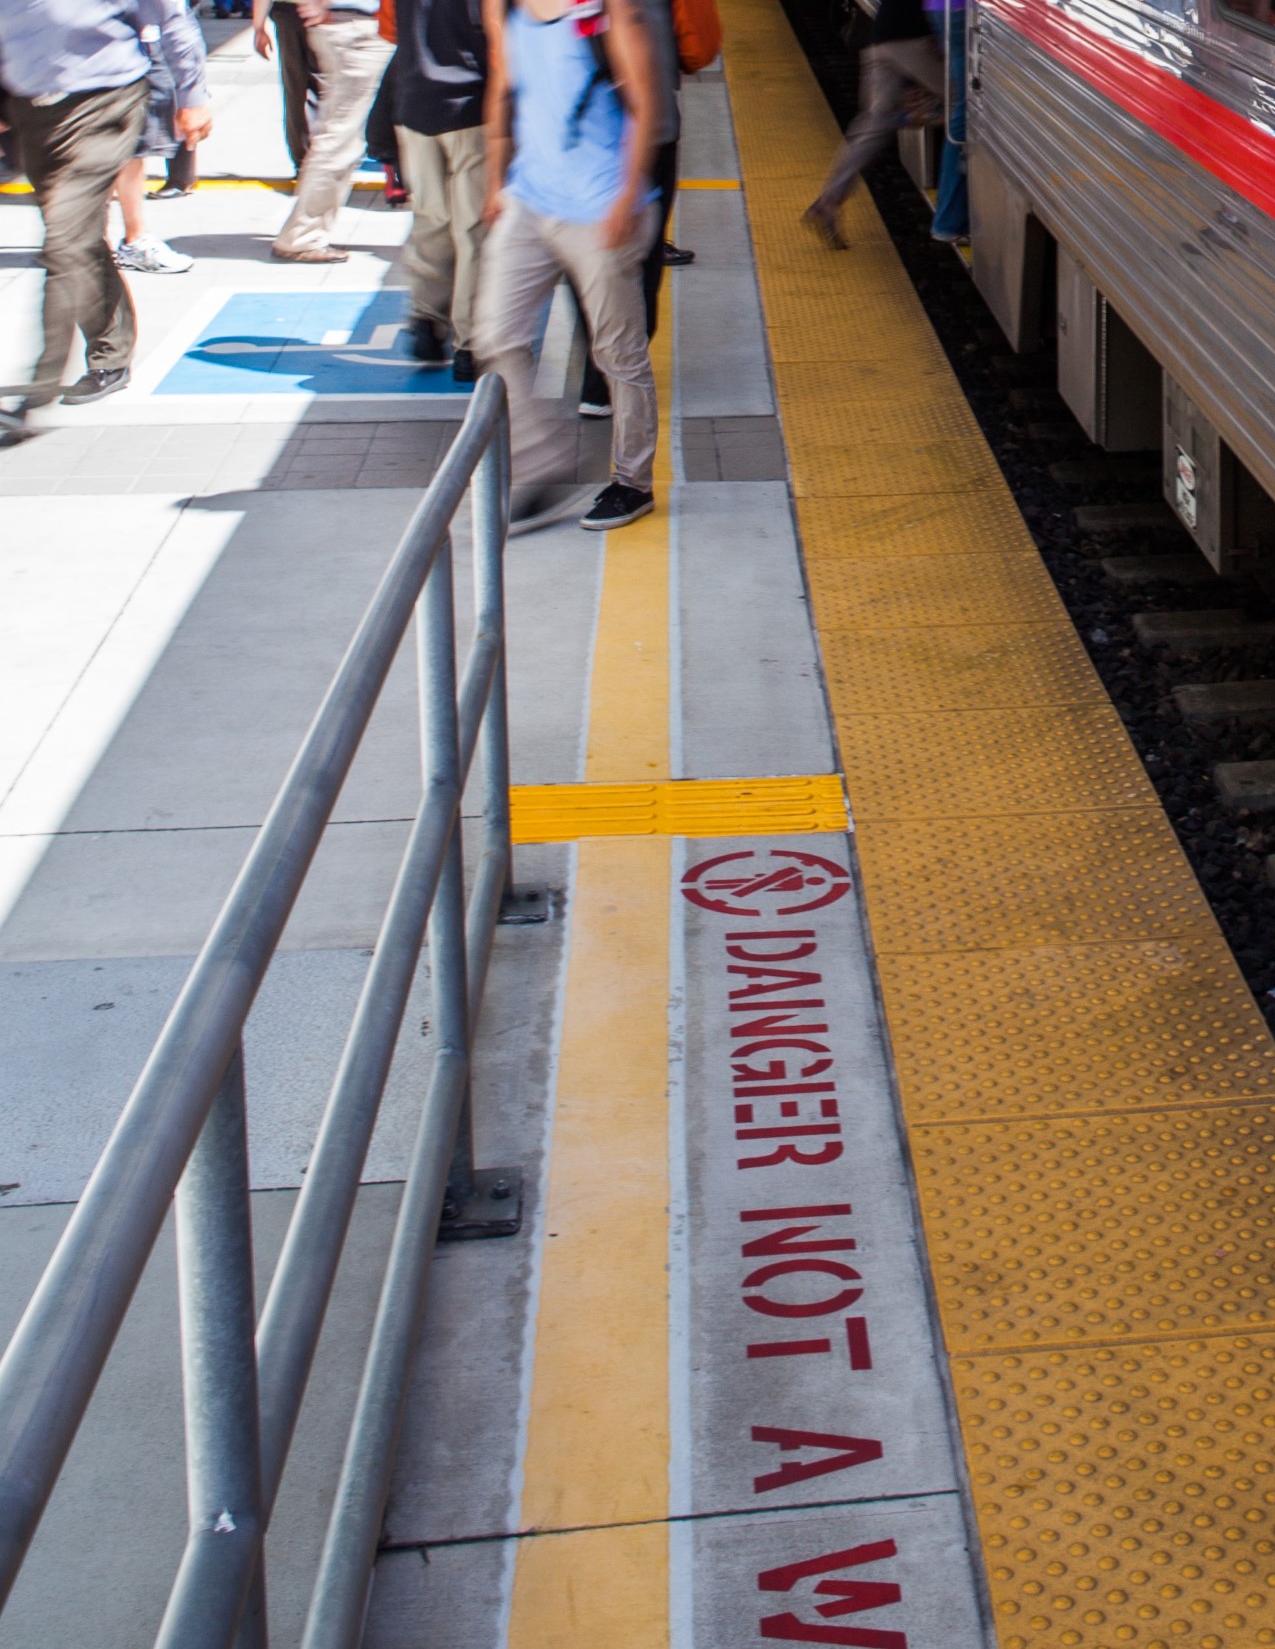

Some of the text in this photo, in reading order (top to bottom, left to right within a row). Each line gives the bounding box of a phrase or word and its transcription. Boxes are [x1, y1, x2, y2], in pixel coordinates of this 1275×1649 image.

[724, 929, 845, 1171] DANGER
[739, 1203, 873, 1371] NOT
[750, 1425, 884, 1495] A
